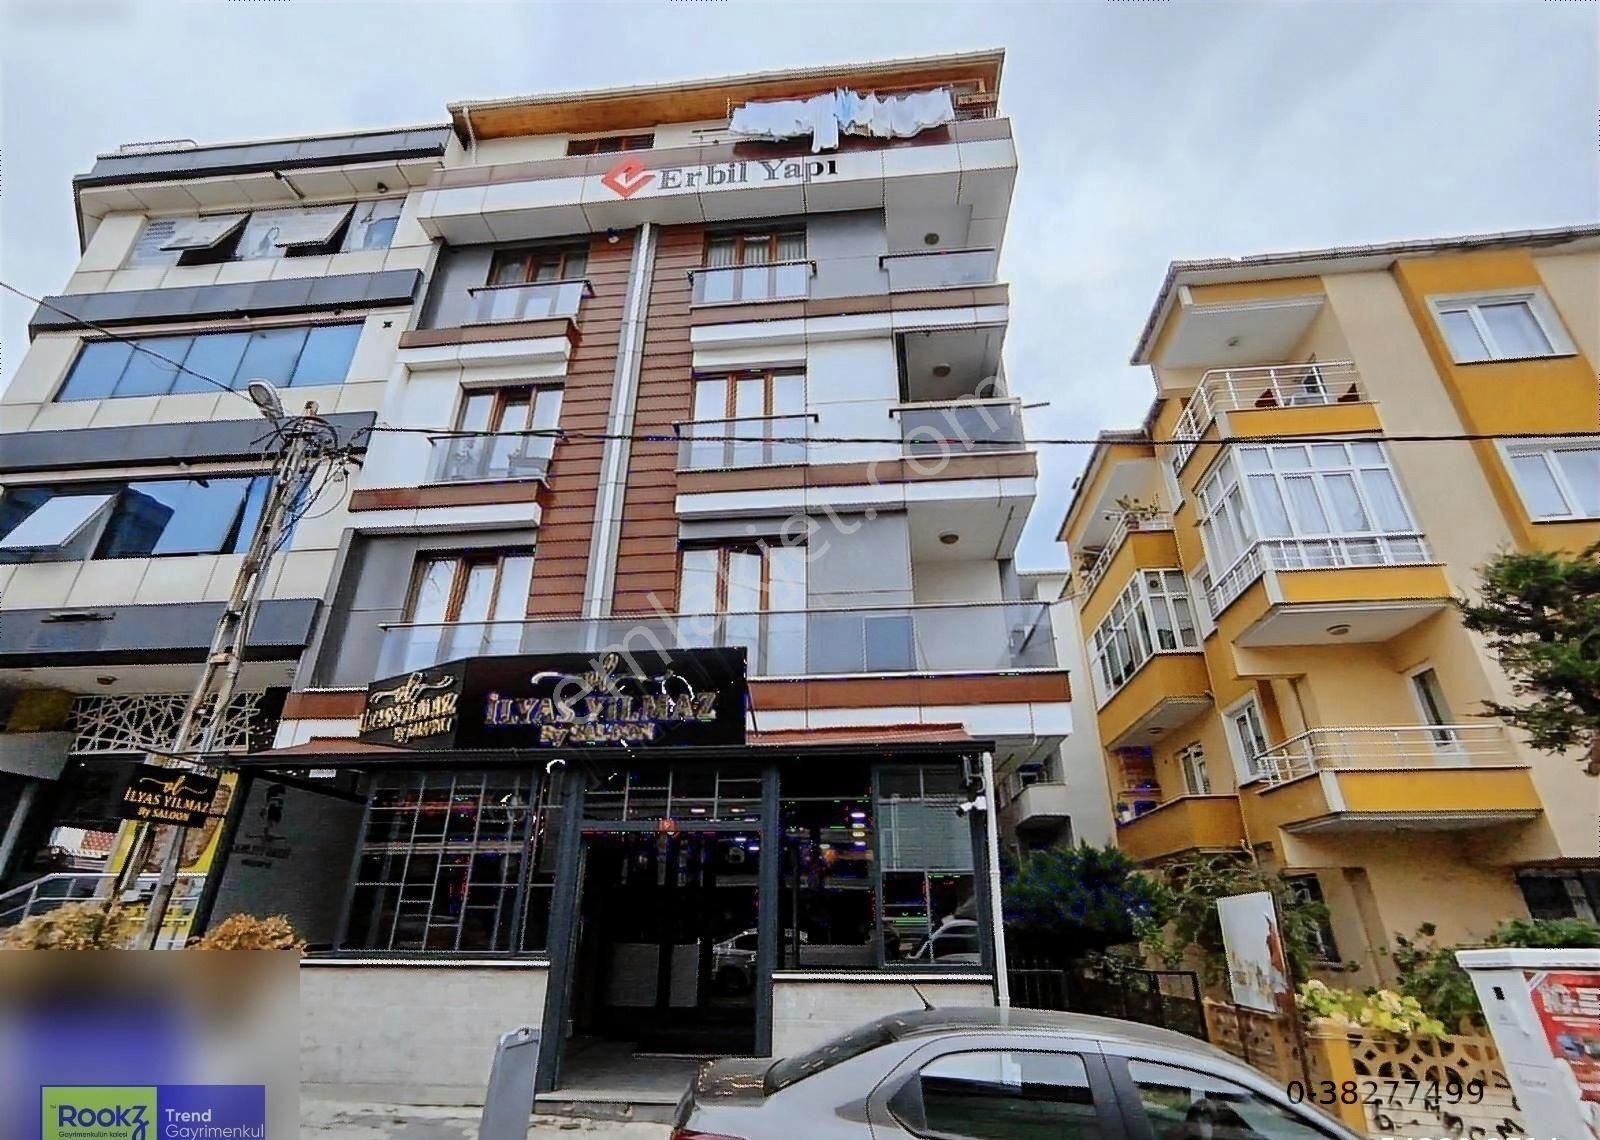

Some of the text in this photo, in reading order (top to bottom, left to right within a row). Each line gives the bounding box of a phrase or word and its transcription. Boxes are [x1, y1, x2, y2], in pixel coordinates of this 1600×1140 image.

[657, 159, 838, 190] Erbil Yapı
[484, 693, 577, 724] İLYAS
[124, 786, 210, 813] İLYAS YILMAZ
